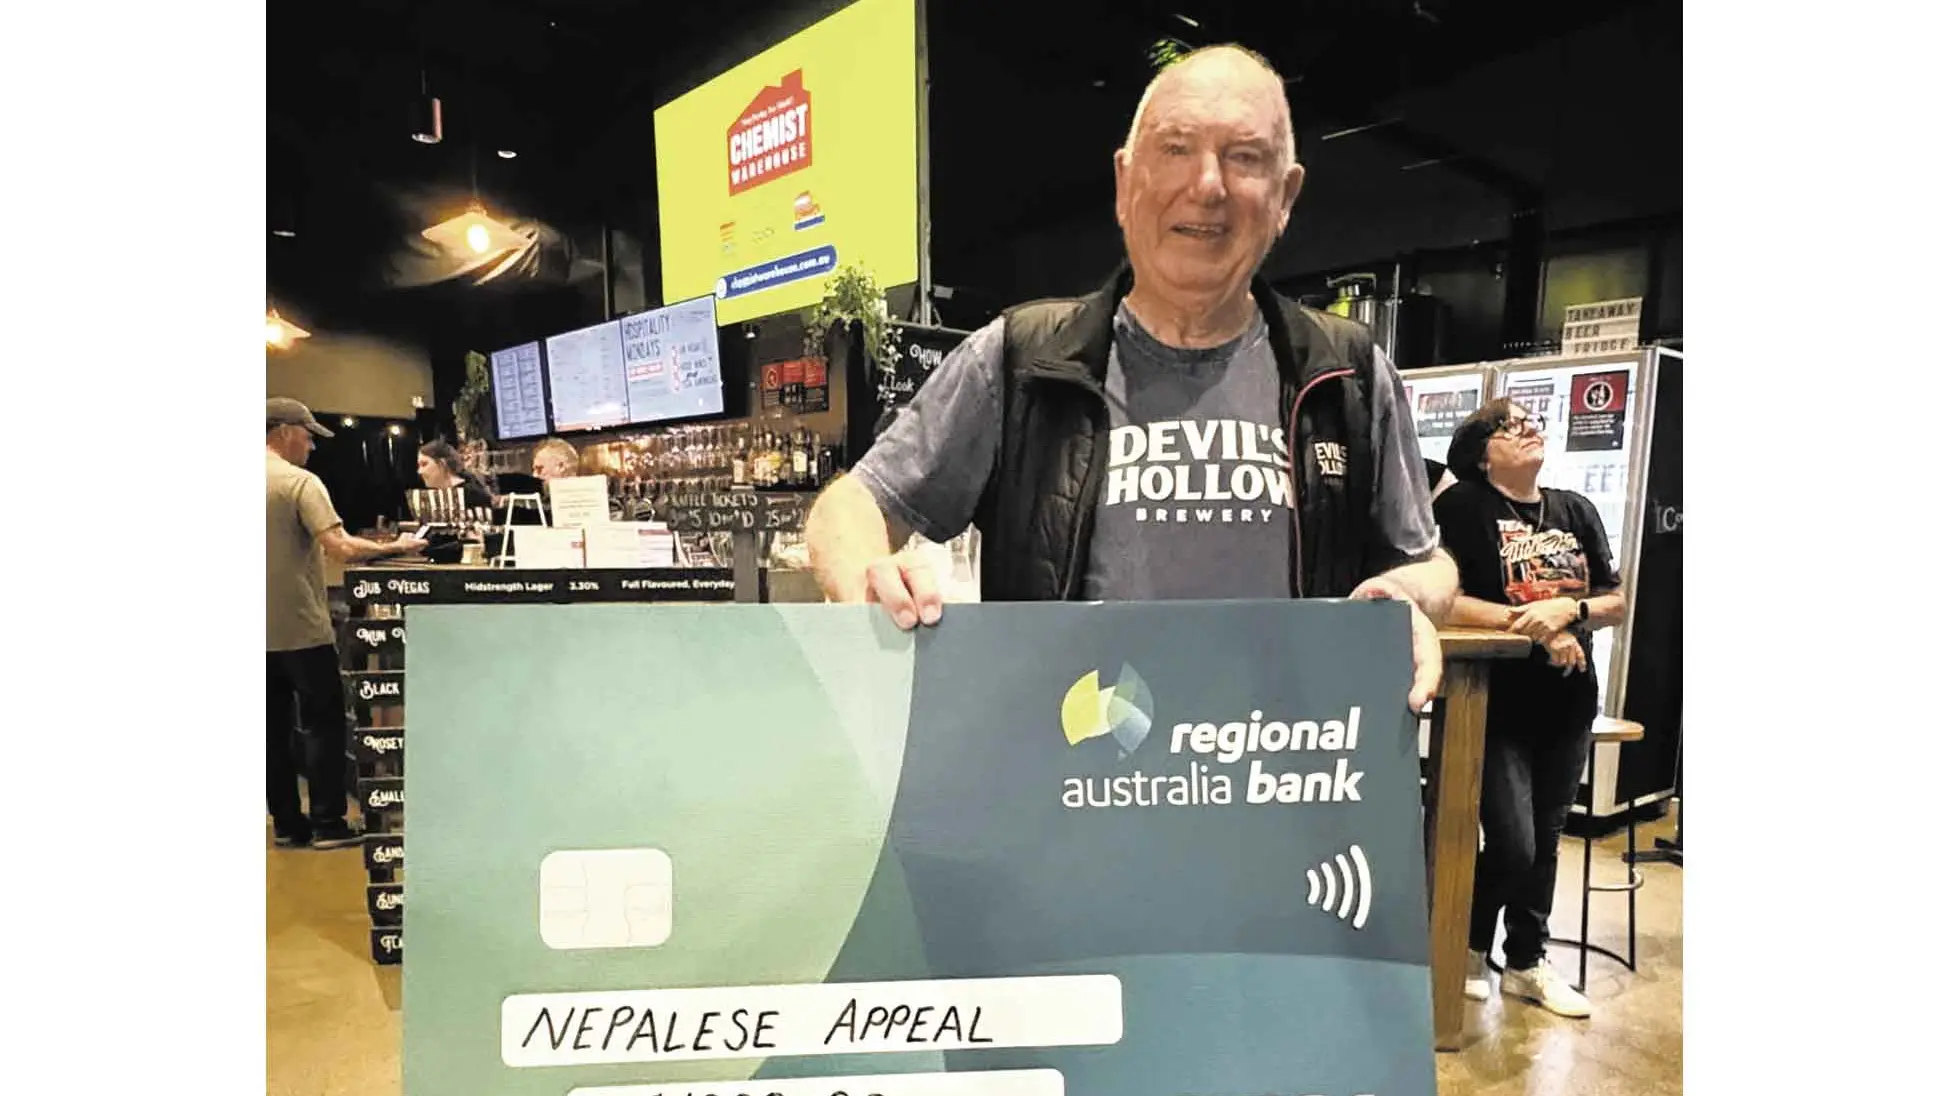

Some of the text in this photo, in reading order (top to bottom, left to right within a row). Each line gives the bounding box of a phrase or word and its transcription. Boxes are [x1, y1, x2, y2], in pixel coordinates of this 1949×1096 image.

[730, 103, 808, 166] CHEMIST
[731, 142, 806, 186] WAREHOUSE
[1565, 324, 1600, 340] BEER
[1567, 302, 1635, 322] TAKEAWAY
[910, 343, 943, 370] HOW
[1109, 419, 1291, 467] DEVIL'S
[1106, 463, 1294, 508] HOLLOW
[1135, 508, 1273, 522] BREWERY
[353, 580, 381, 598] DUB
[387, 580, 430, 594] VEGAS
[465, 582, 523, 592] Midstrength
[525, 582, 553, 592] Lager
[622, 580, 640, 588] Full
[360, 681, 400, 700] BLACK
[1170, 706, 1361, 763] regional
[1061, 758, 1365, 808] australia bank
[521, 998, 994, 1053] NEPALESE APPEAL
